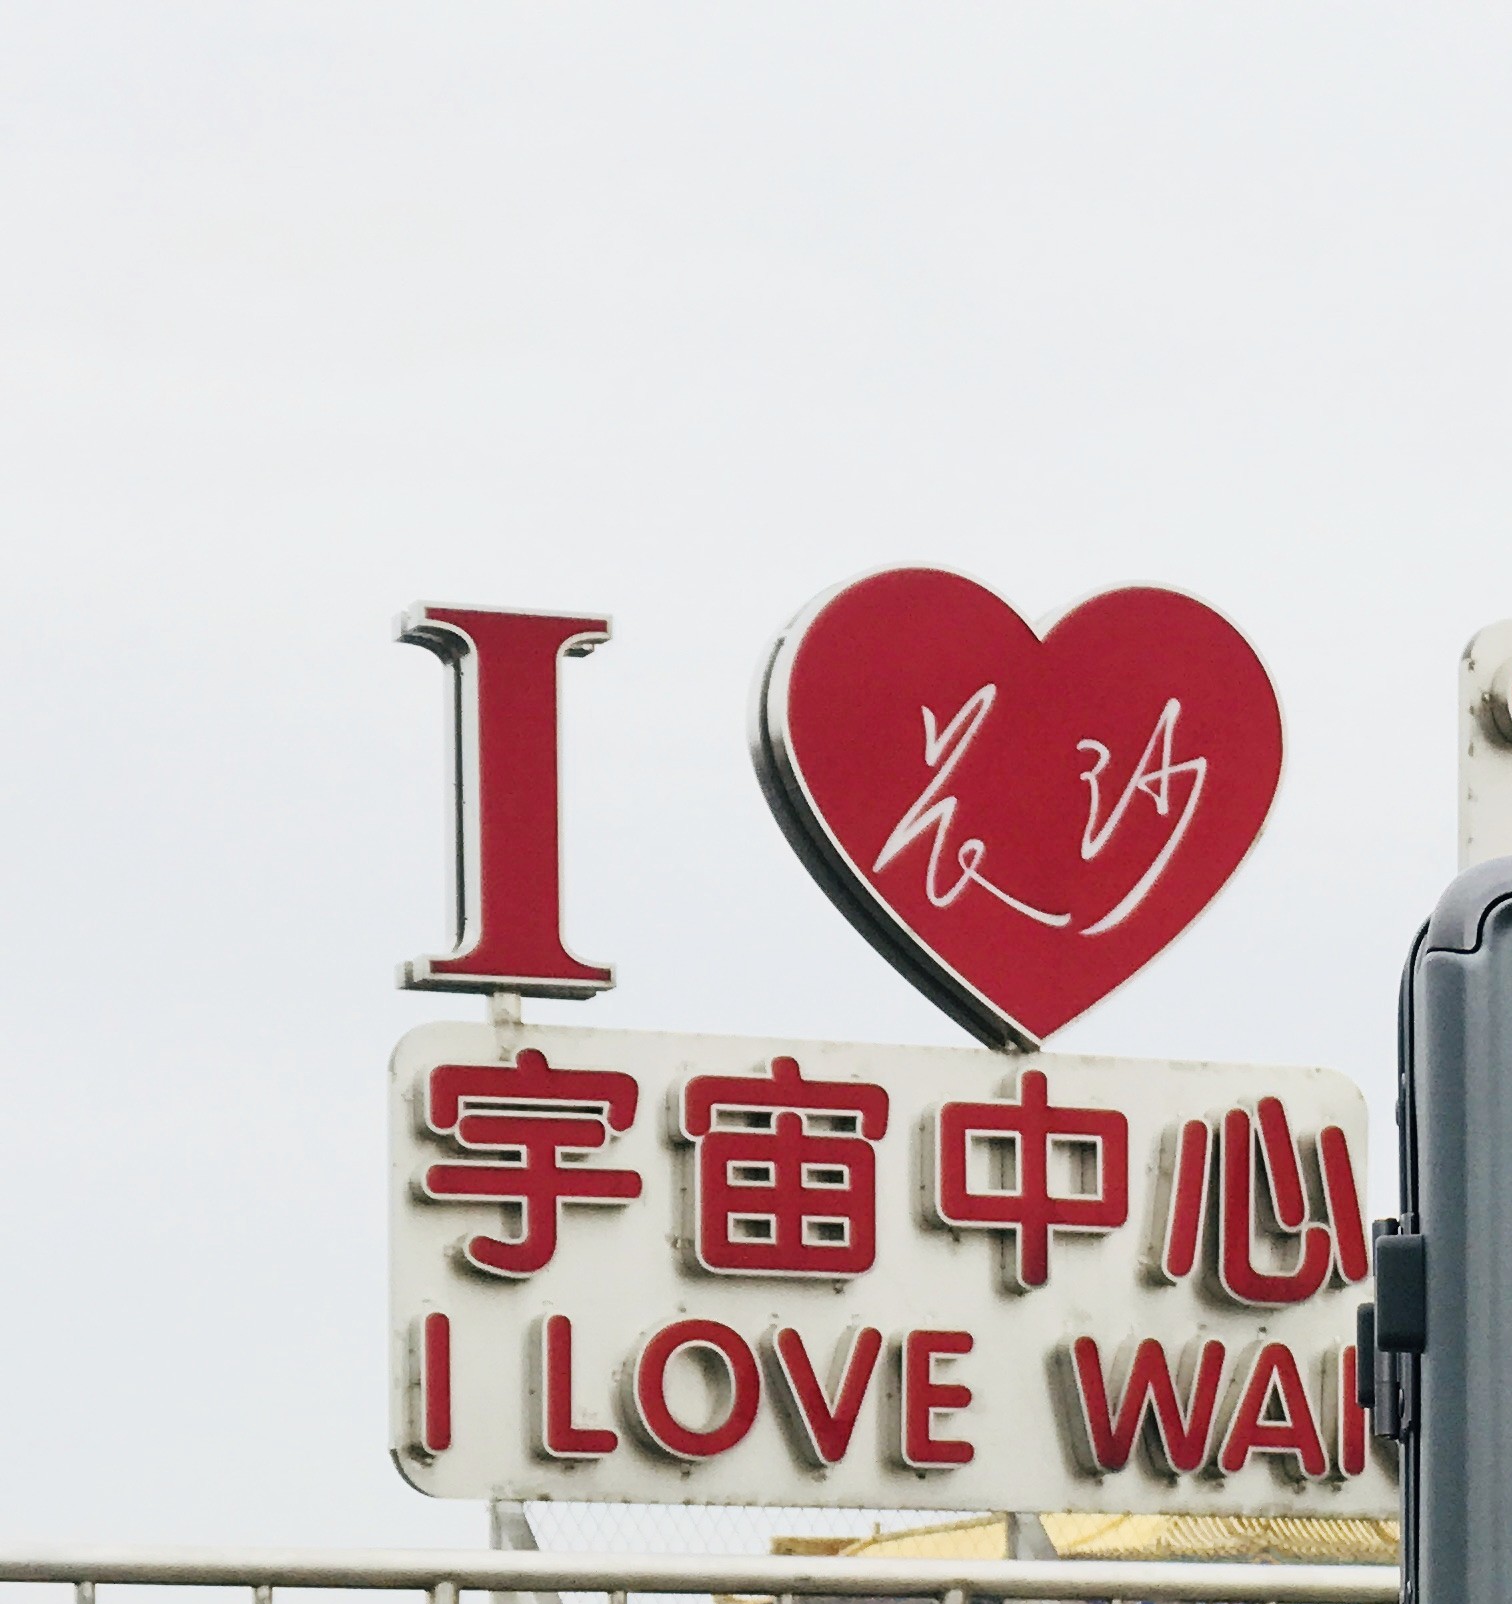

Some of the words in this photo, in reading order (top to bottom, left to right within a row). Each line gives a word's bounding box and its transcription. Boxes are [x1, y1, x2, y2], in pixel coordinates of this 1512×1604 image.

[424, 605, 613, 986] I
[425, 1048, 1369, 1304] 宇宙中心
[425, 1312, 453, 1452] I
[546, 1316, 976, 1464] LOVE
